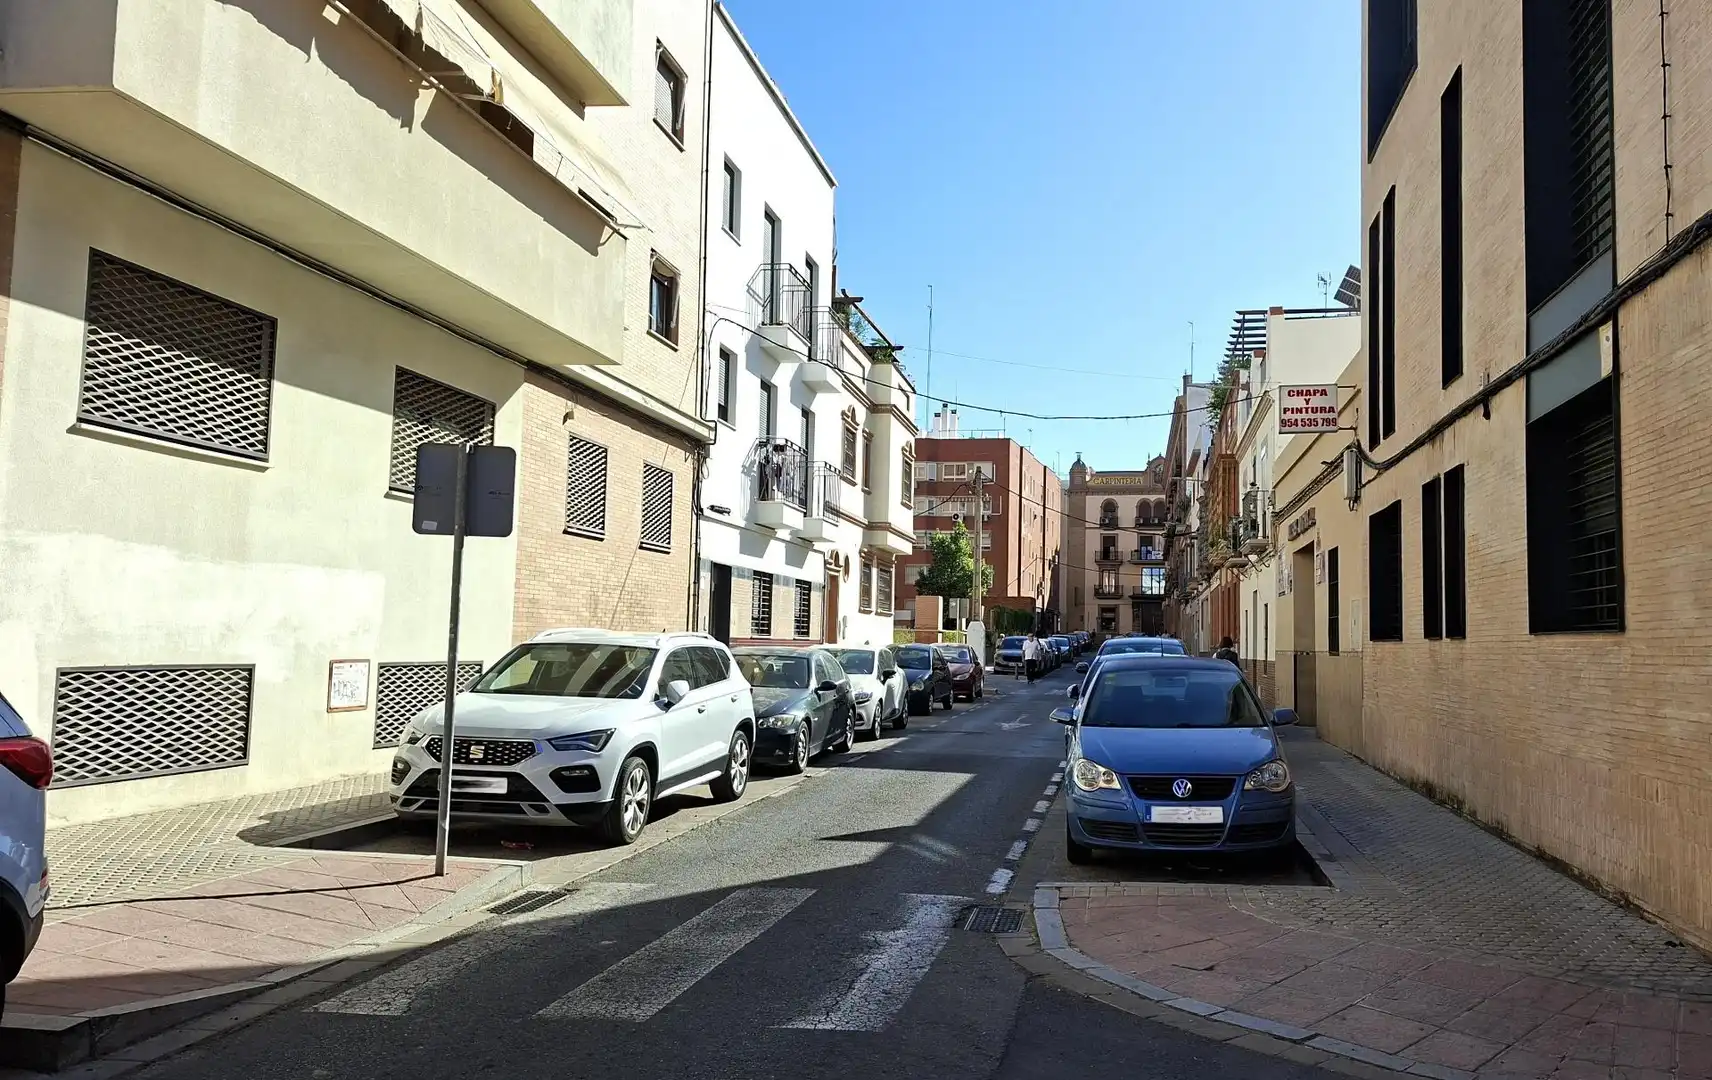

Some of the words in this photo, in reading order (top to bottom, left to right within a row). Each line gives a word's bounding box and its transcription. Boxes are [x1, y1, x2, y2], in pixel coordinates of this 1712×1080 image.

[1287, 389, 1328, 397] CHAPA
[1283, 406, 1336, 414] PINTURA
[1281, 418, 1299, 427] 954
[1300, 418, 1319, 427] 535
[1320, 418, 1337, 427] 799
